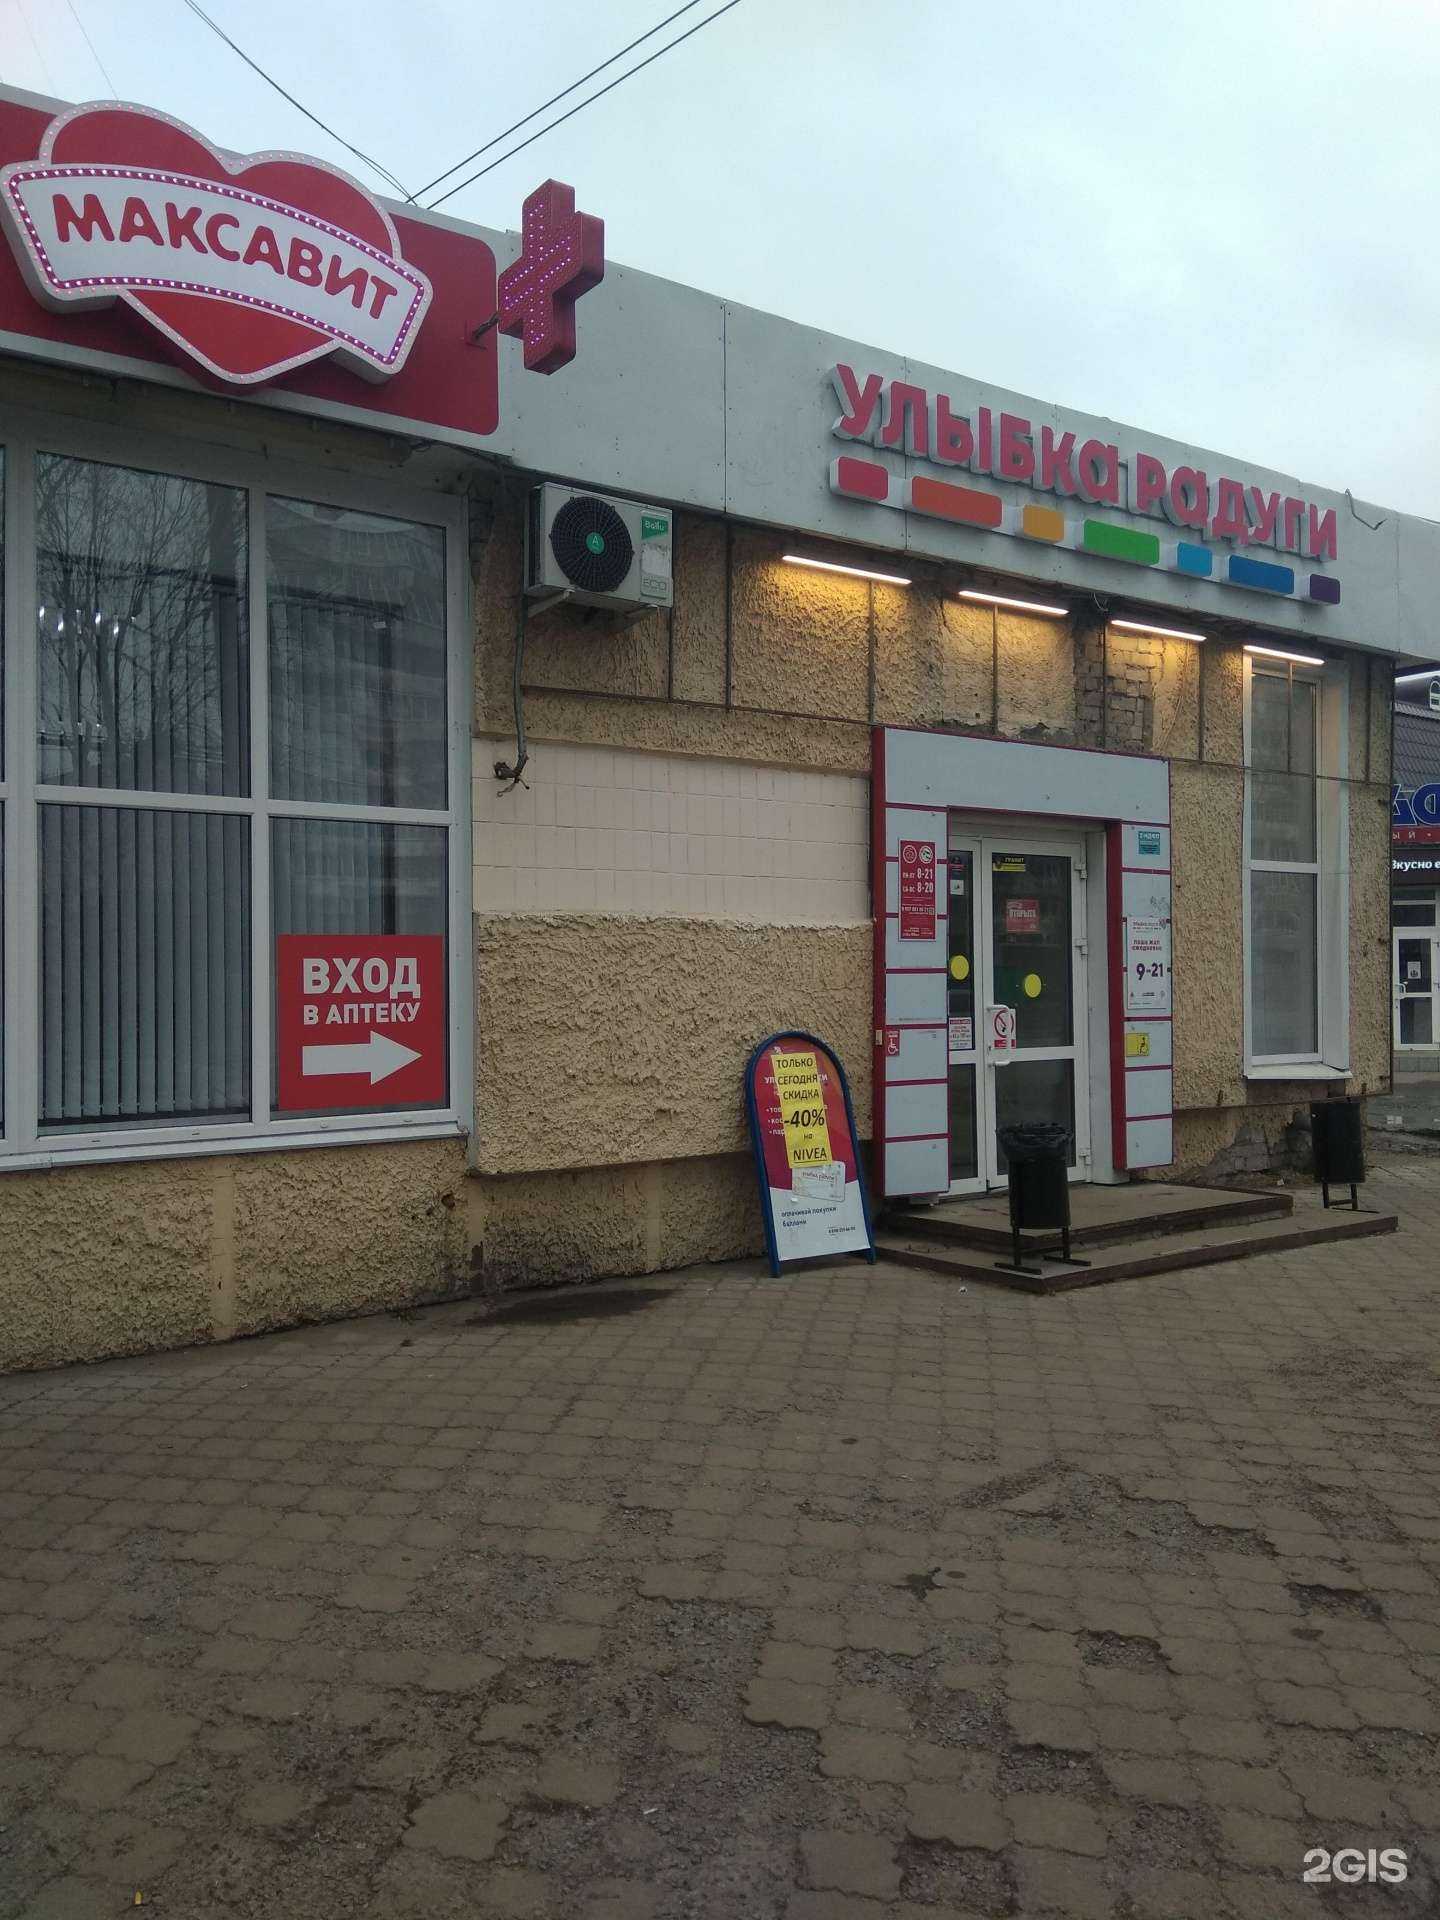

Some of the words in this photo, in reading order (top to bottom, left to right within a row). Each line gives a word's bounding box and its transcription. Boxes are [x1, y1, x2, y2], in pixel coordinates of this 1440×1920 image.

[51, 193, 398, 320] МАКСАВИТ
[302, 957, 421, 1000] ВХОД
[1136, 963, 1164, 981] 9-21
[303, 1004, 320, 1025] В
[325, 1002, 421, 1025] АПТЕКУ
[776, 1057, 814, 1069] ТОЛЬКО
[777, 1075, 818, 1086] СЕГОДНЯ
[783, 1089, 820, 1101] СКИДКА
[784, 1108, 825, 1129] -40%
[793, 1147, 827, 1161] NIVEA
